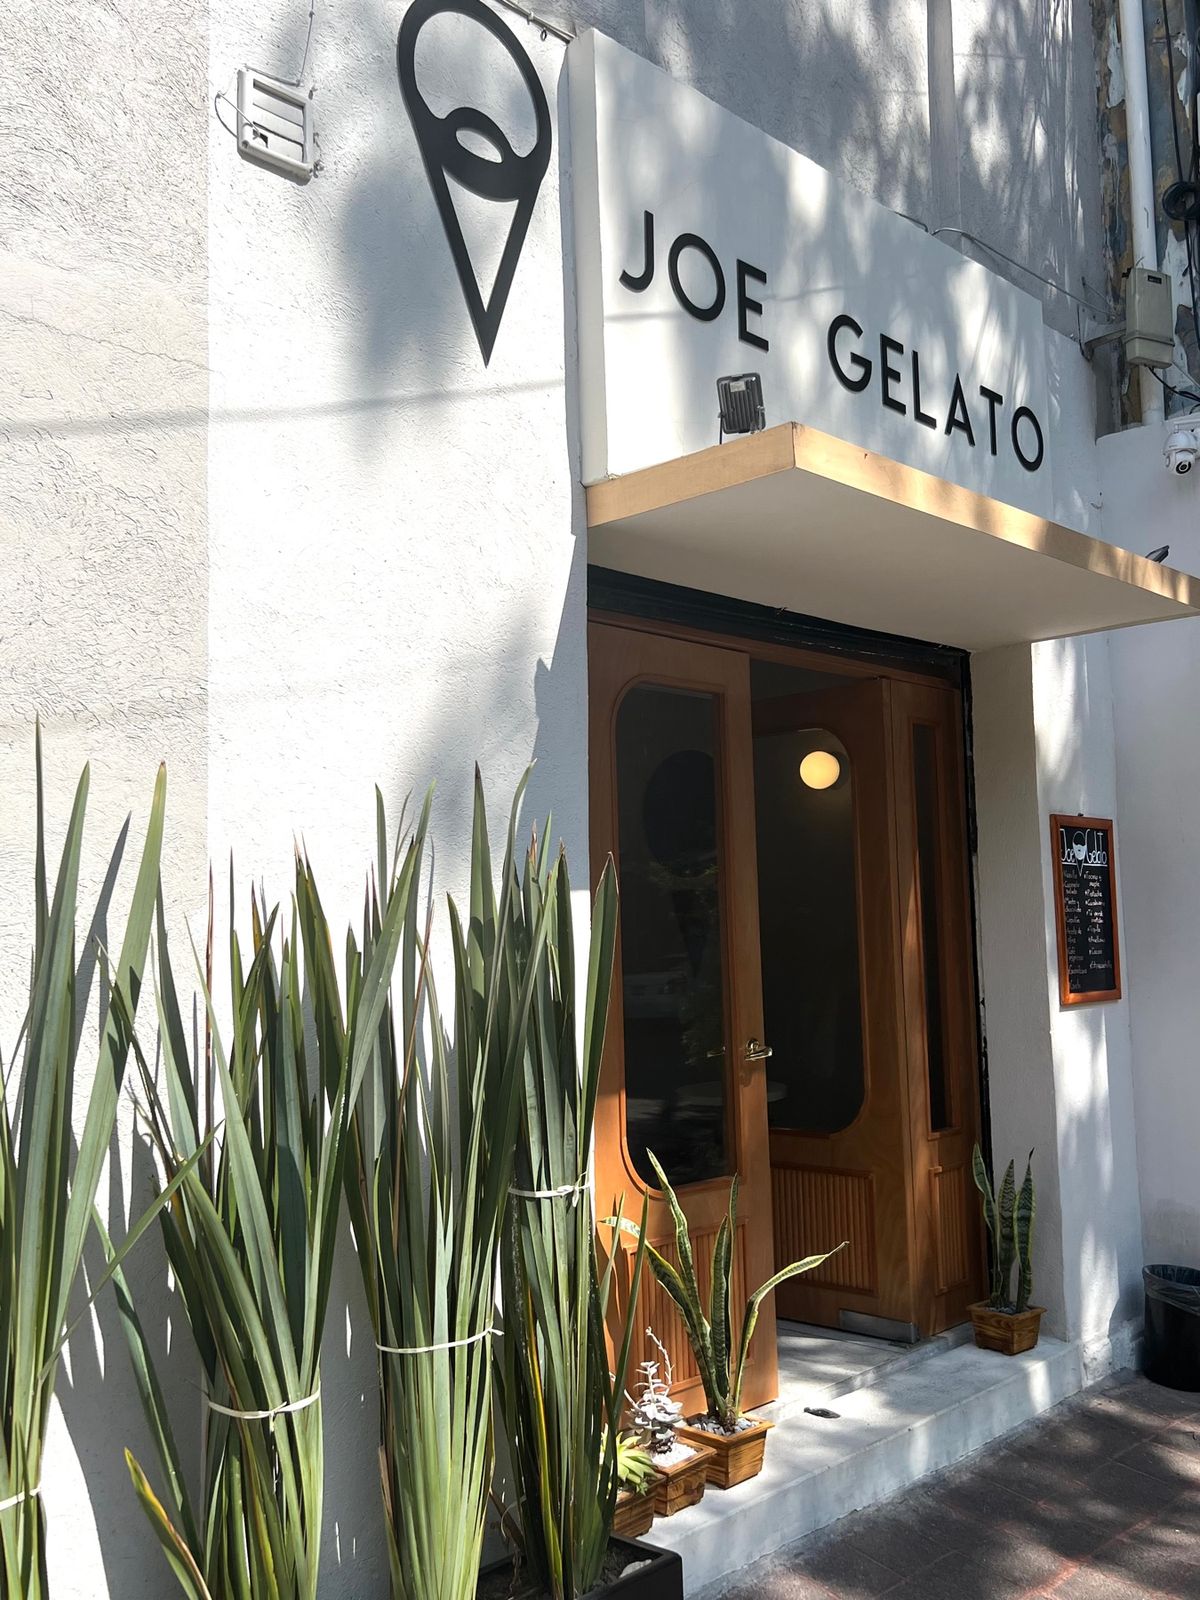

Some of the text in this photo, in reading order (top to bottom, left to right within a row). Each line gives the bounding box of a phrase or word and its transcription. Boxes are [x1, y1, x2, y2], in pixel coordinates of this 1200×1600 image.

[618, 209, 1044, 472] JOE GELATO
[1060, 828, 1075, 862] Joe
